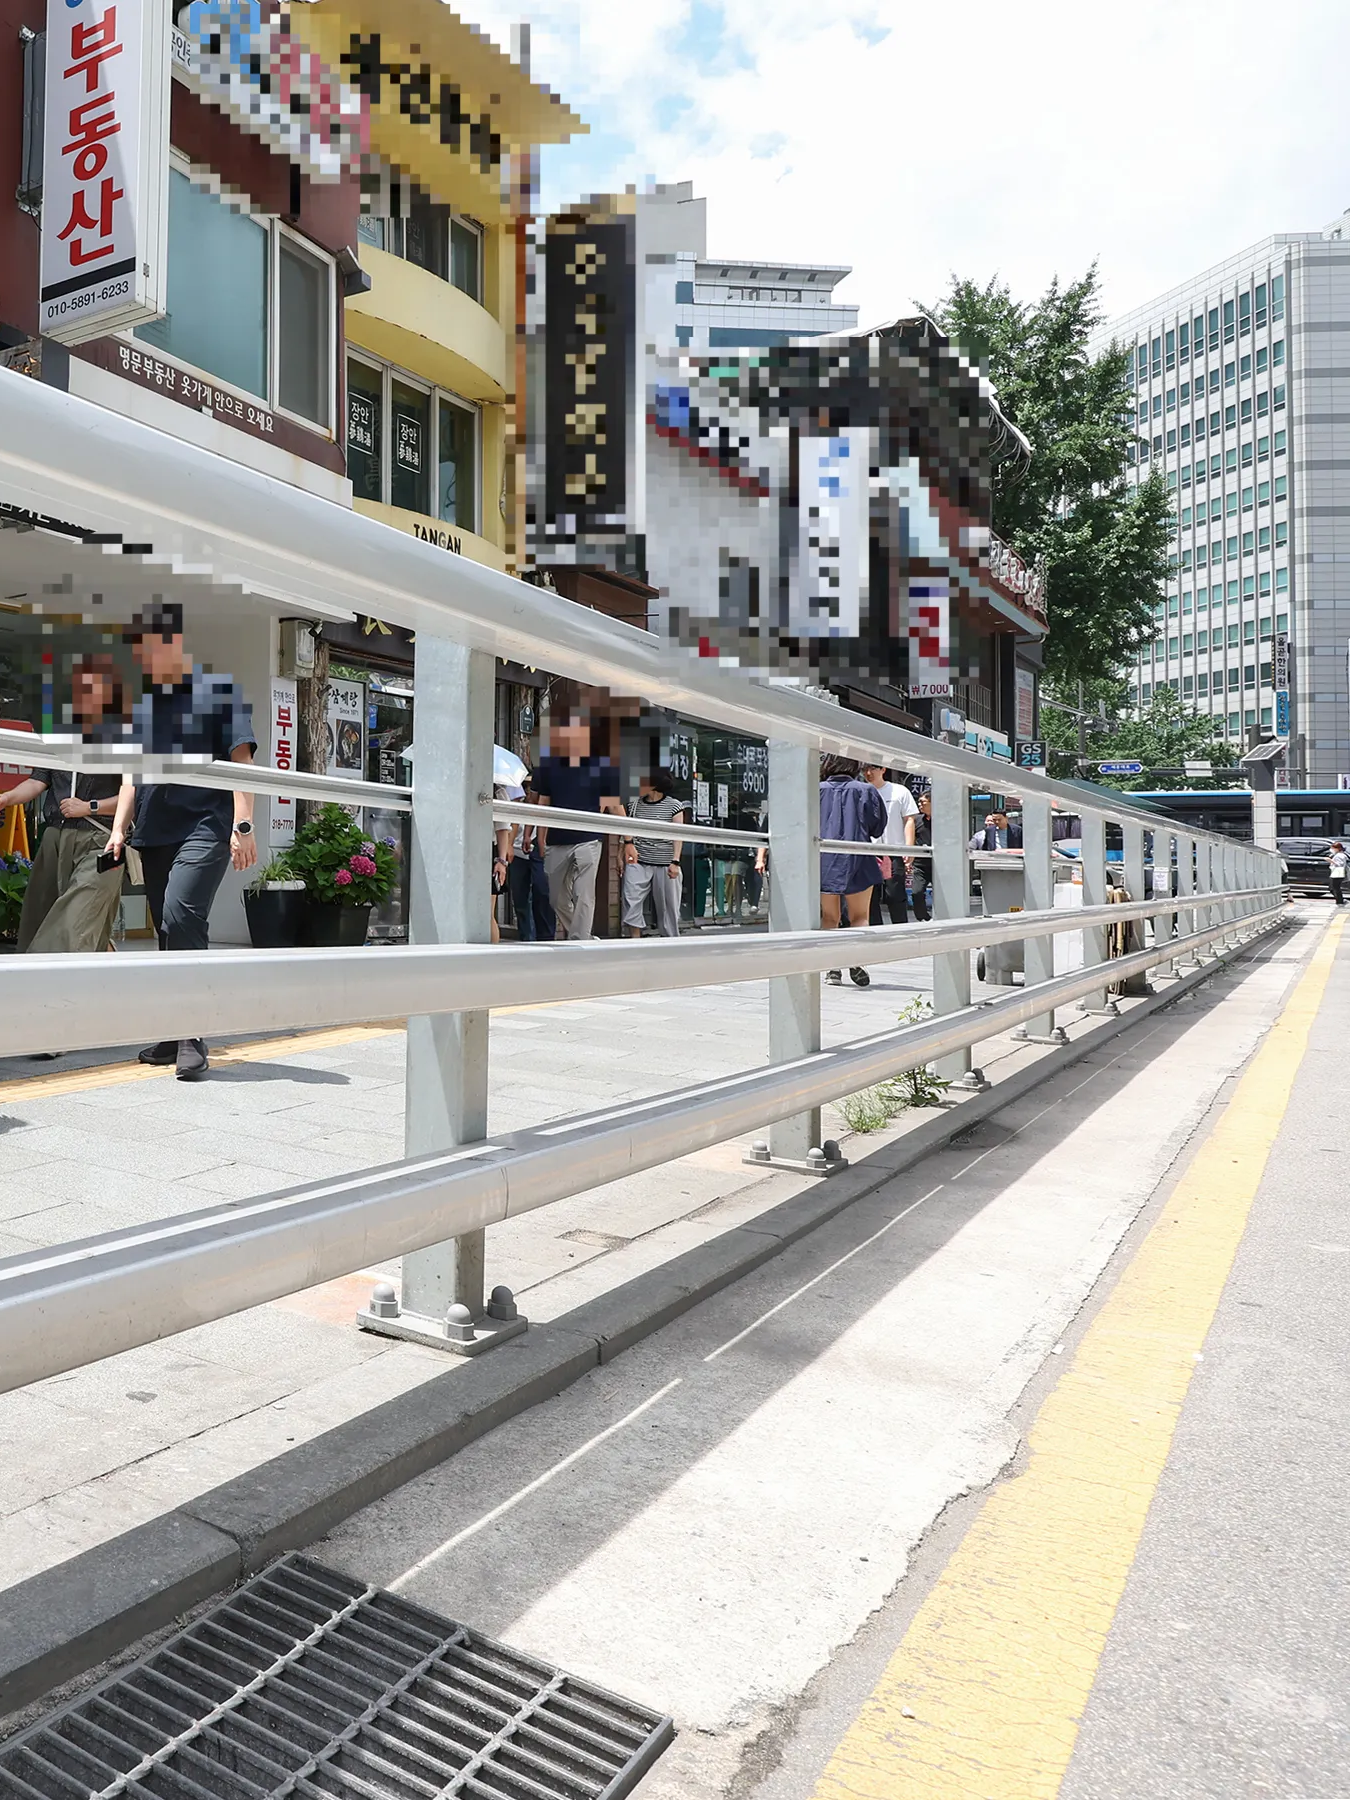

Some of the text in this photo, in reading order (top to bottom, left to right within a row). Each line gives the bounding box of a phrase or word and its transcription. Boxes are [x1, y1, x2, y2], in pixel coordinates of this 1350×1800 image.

[57, 6, 124, 267] 부동산
[47, 280, 130, 319] 010-5891-6233
[118, 345, 275, 433] 명문부동산 옷가게 안으로 오세요
[351, 401, 369, 424] 장안
[400, 423, 417, 445] 장안
[413, 523, 462, 555] TANGAN
[329, 688, 359, 709] 삼계탕
[275, 705, 293, 804] 부동
[1021, 743, 1042, 754] GS
[1021, 754, 1041, 765] 25
[272, 819, 294, 830] 318-7770
